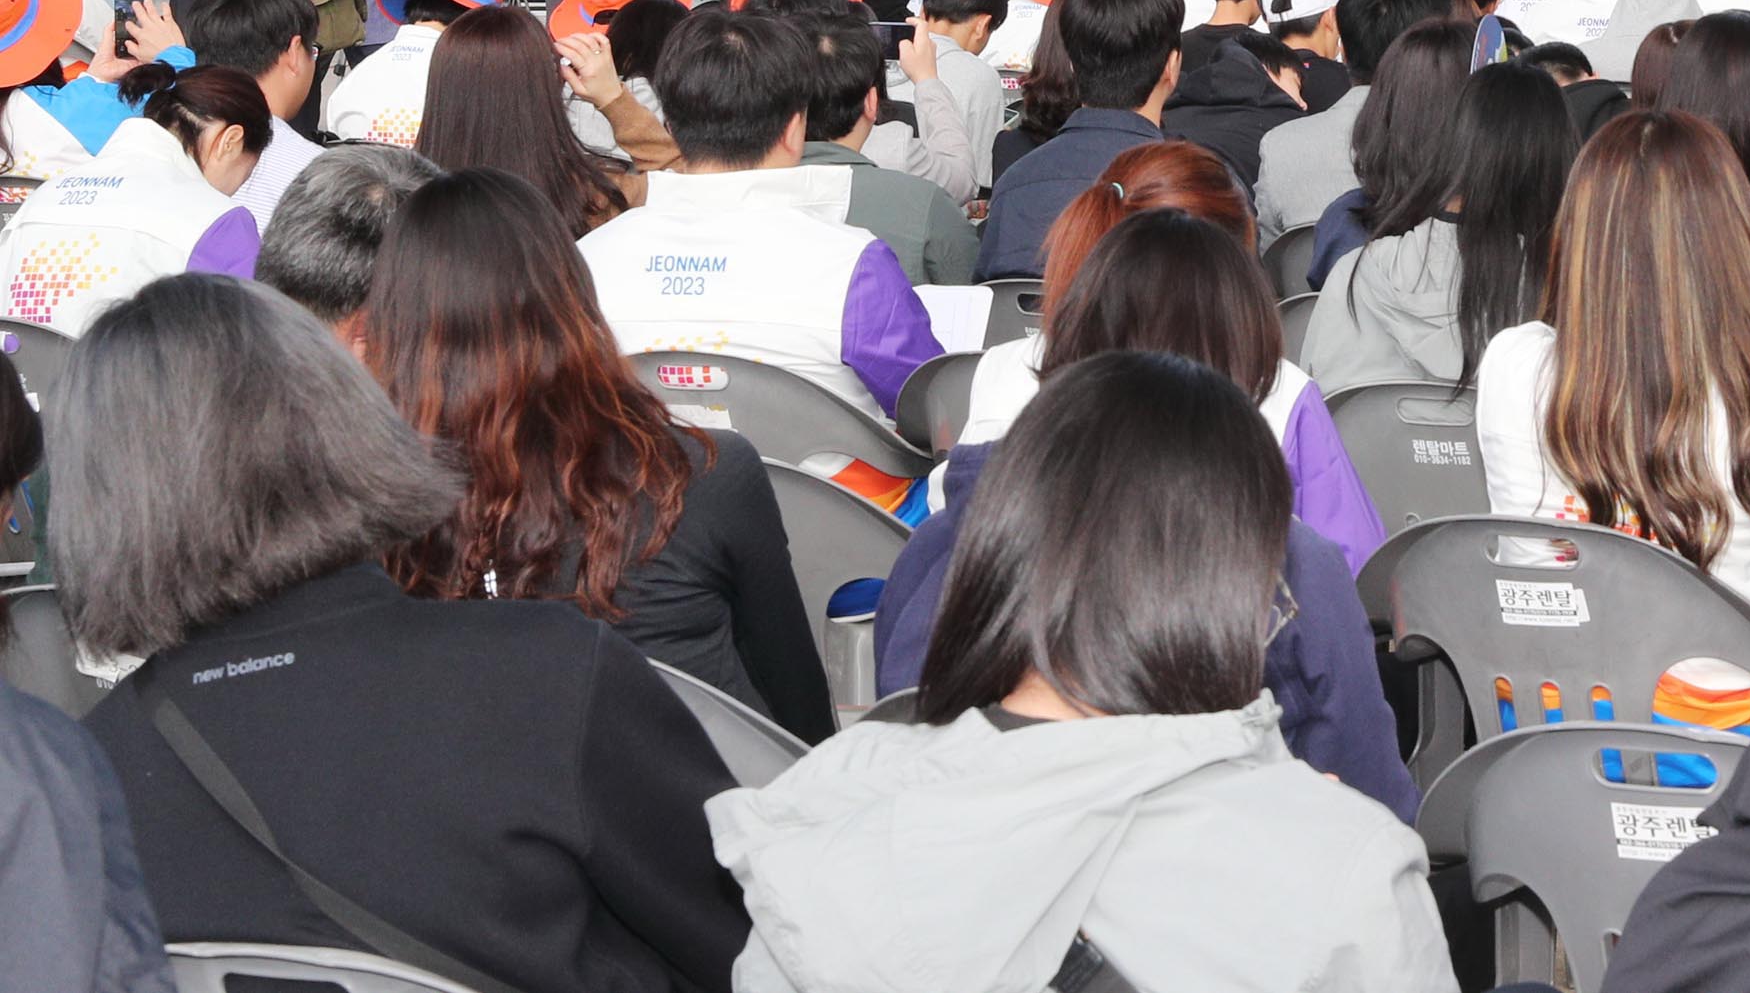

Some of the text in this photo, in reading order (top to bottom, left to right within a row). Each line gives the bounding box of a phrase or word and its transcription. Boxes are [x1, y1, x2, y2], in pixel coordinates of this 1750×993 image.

[56, 176, 124, 189] JEONNAM
[58, 190, 98, 205] 2023
[645, 255, 727, 272] JEONNAM
[661, 276, 705, 295] 2023
[1412, 439, 1470, 456] 렌탈마트
[1501, 588, 1573, 607] 광주렌탈
[193, 652, 295, 684] new balance
